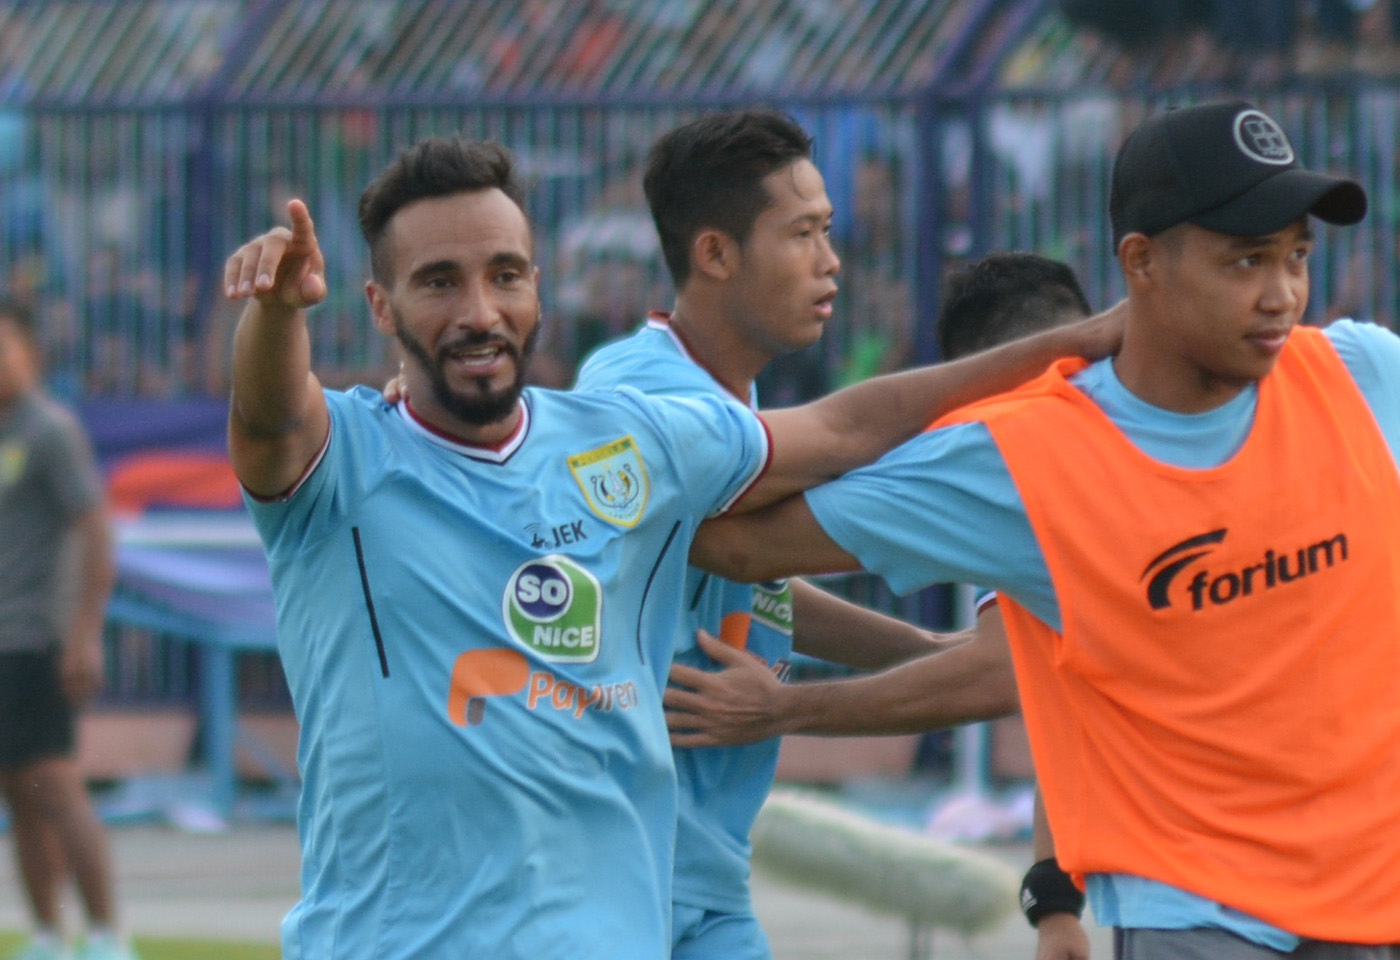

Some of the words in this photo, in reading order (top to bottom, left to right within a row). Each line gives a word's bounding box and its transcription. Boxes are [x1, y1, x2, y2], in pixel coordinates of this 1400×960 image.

[1187, 532, 1348, 612] forium
[518, 574, 568, 606] SO
[533, 624, 594, 648] NICE
